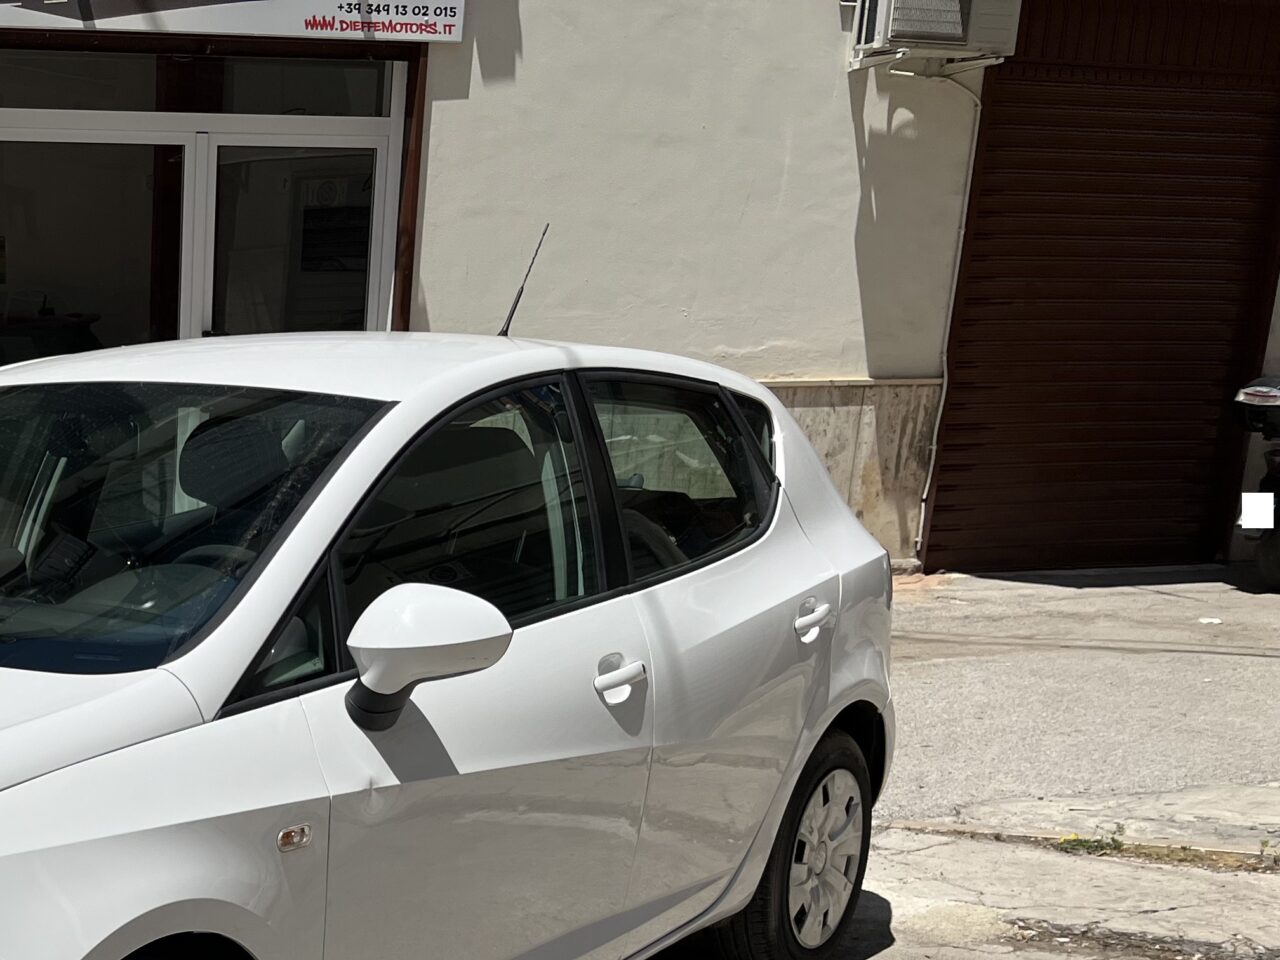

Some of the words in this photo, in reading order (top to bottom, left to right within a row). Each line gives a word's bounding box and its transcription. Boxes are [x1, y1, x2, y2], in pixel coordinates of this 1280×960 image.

[337, 3, 361, 14] +39
[366, 3, 390, 15] 349
[394, 4, 408, 16] 13
[412, 5, 429, 17] 02
[433, 6, 457, 18] 015
[304, 15, 456, 35] WWW.DIEFFEMOTORS.IT
